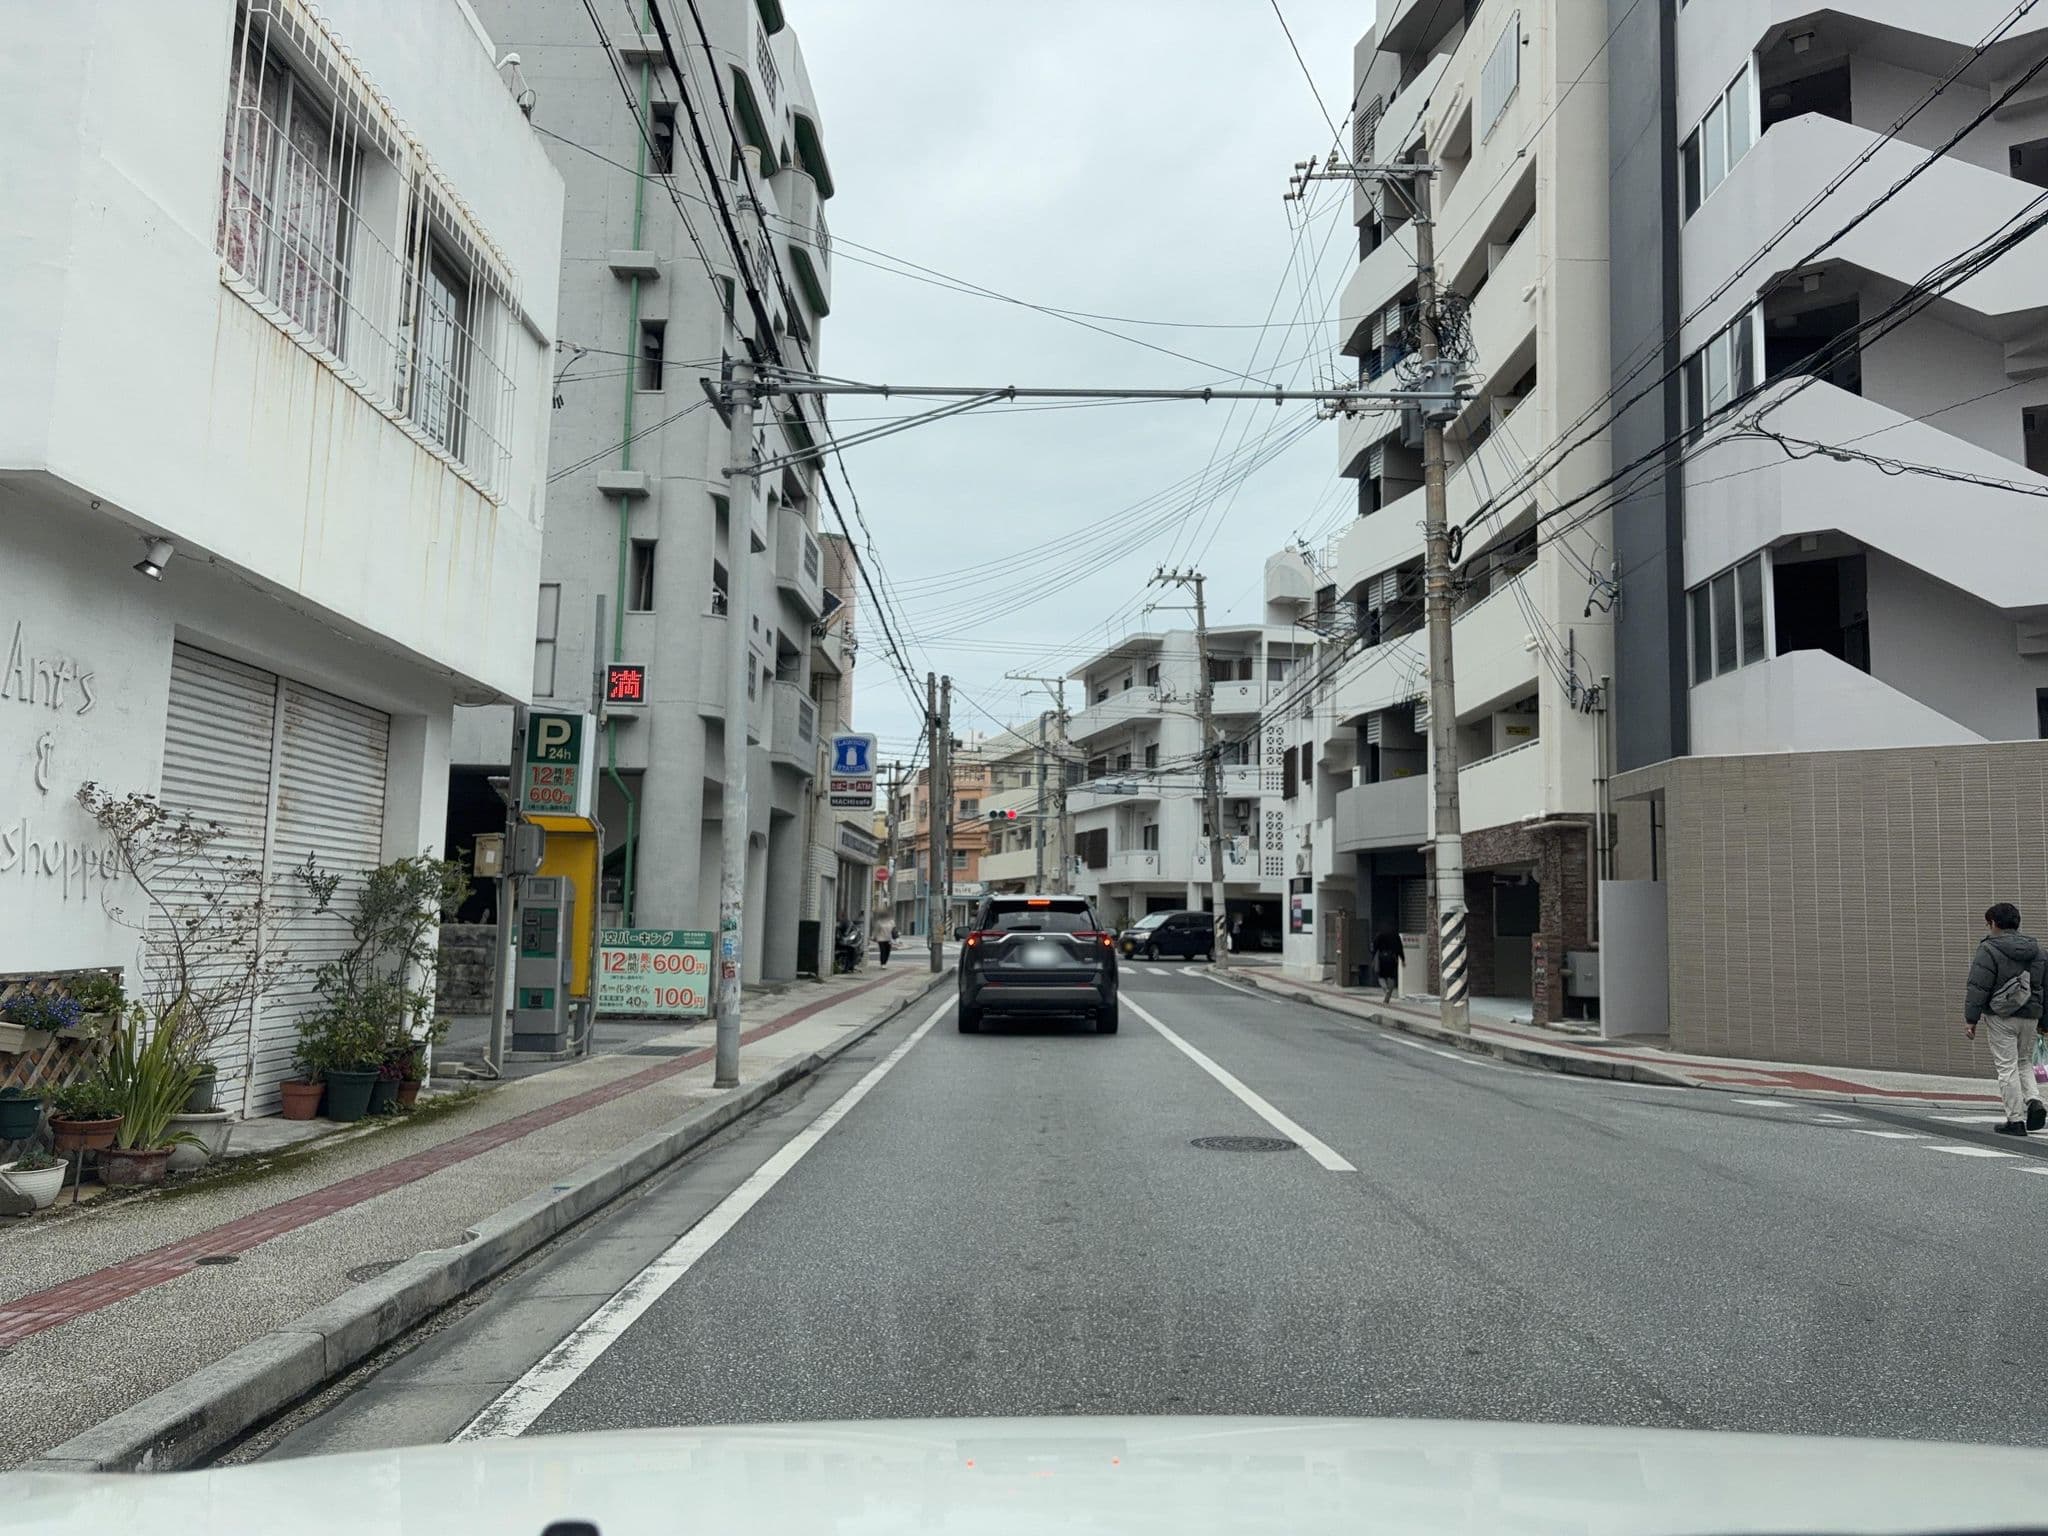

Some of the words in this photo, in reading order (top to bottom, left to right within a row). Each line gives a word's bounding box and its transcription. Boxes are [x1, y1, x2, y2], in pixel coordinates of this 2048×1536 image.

[610, 670, 642, 698] 満
[537, 718, 571, 757] P
[549, 747, 571, 759] 24h
[600, 930, 674, 945] 空パーキング
[654, 986, 706, 1009] 100円
